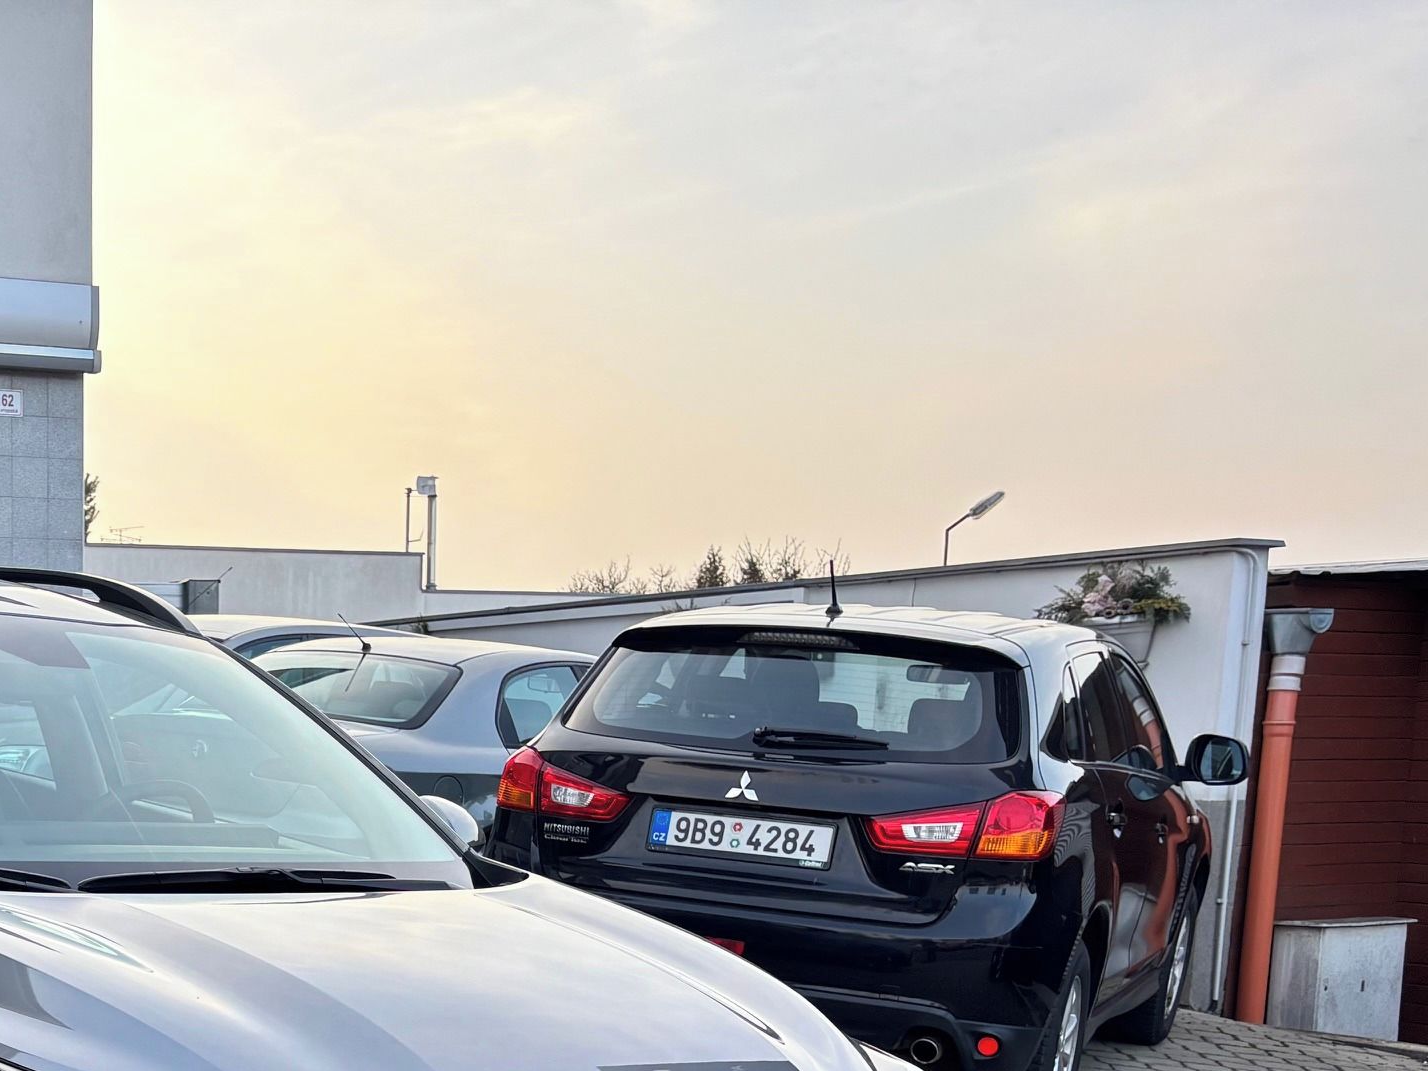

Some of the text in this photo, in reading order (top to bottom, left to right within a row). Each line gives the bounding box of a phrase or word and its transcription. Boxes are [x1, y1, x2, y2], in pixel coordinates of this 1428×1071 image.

[1, 394, 14, 407] 62
[543, 822, 590, 836] MITSUBISHI
[653, 832, 666, 842] CZ
[674, 816, 815, 857] 9B9 4284
[899, 862, 955, 875] ASX
